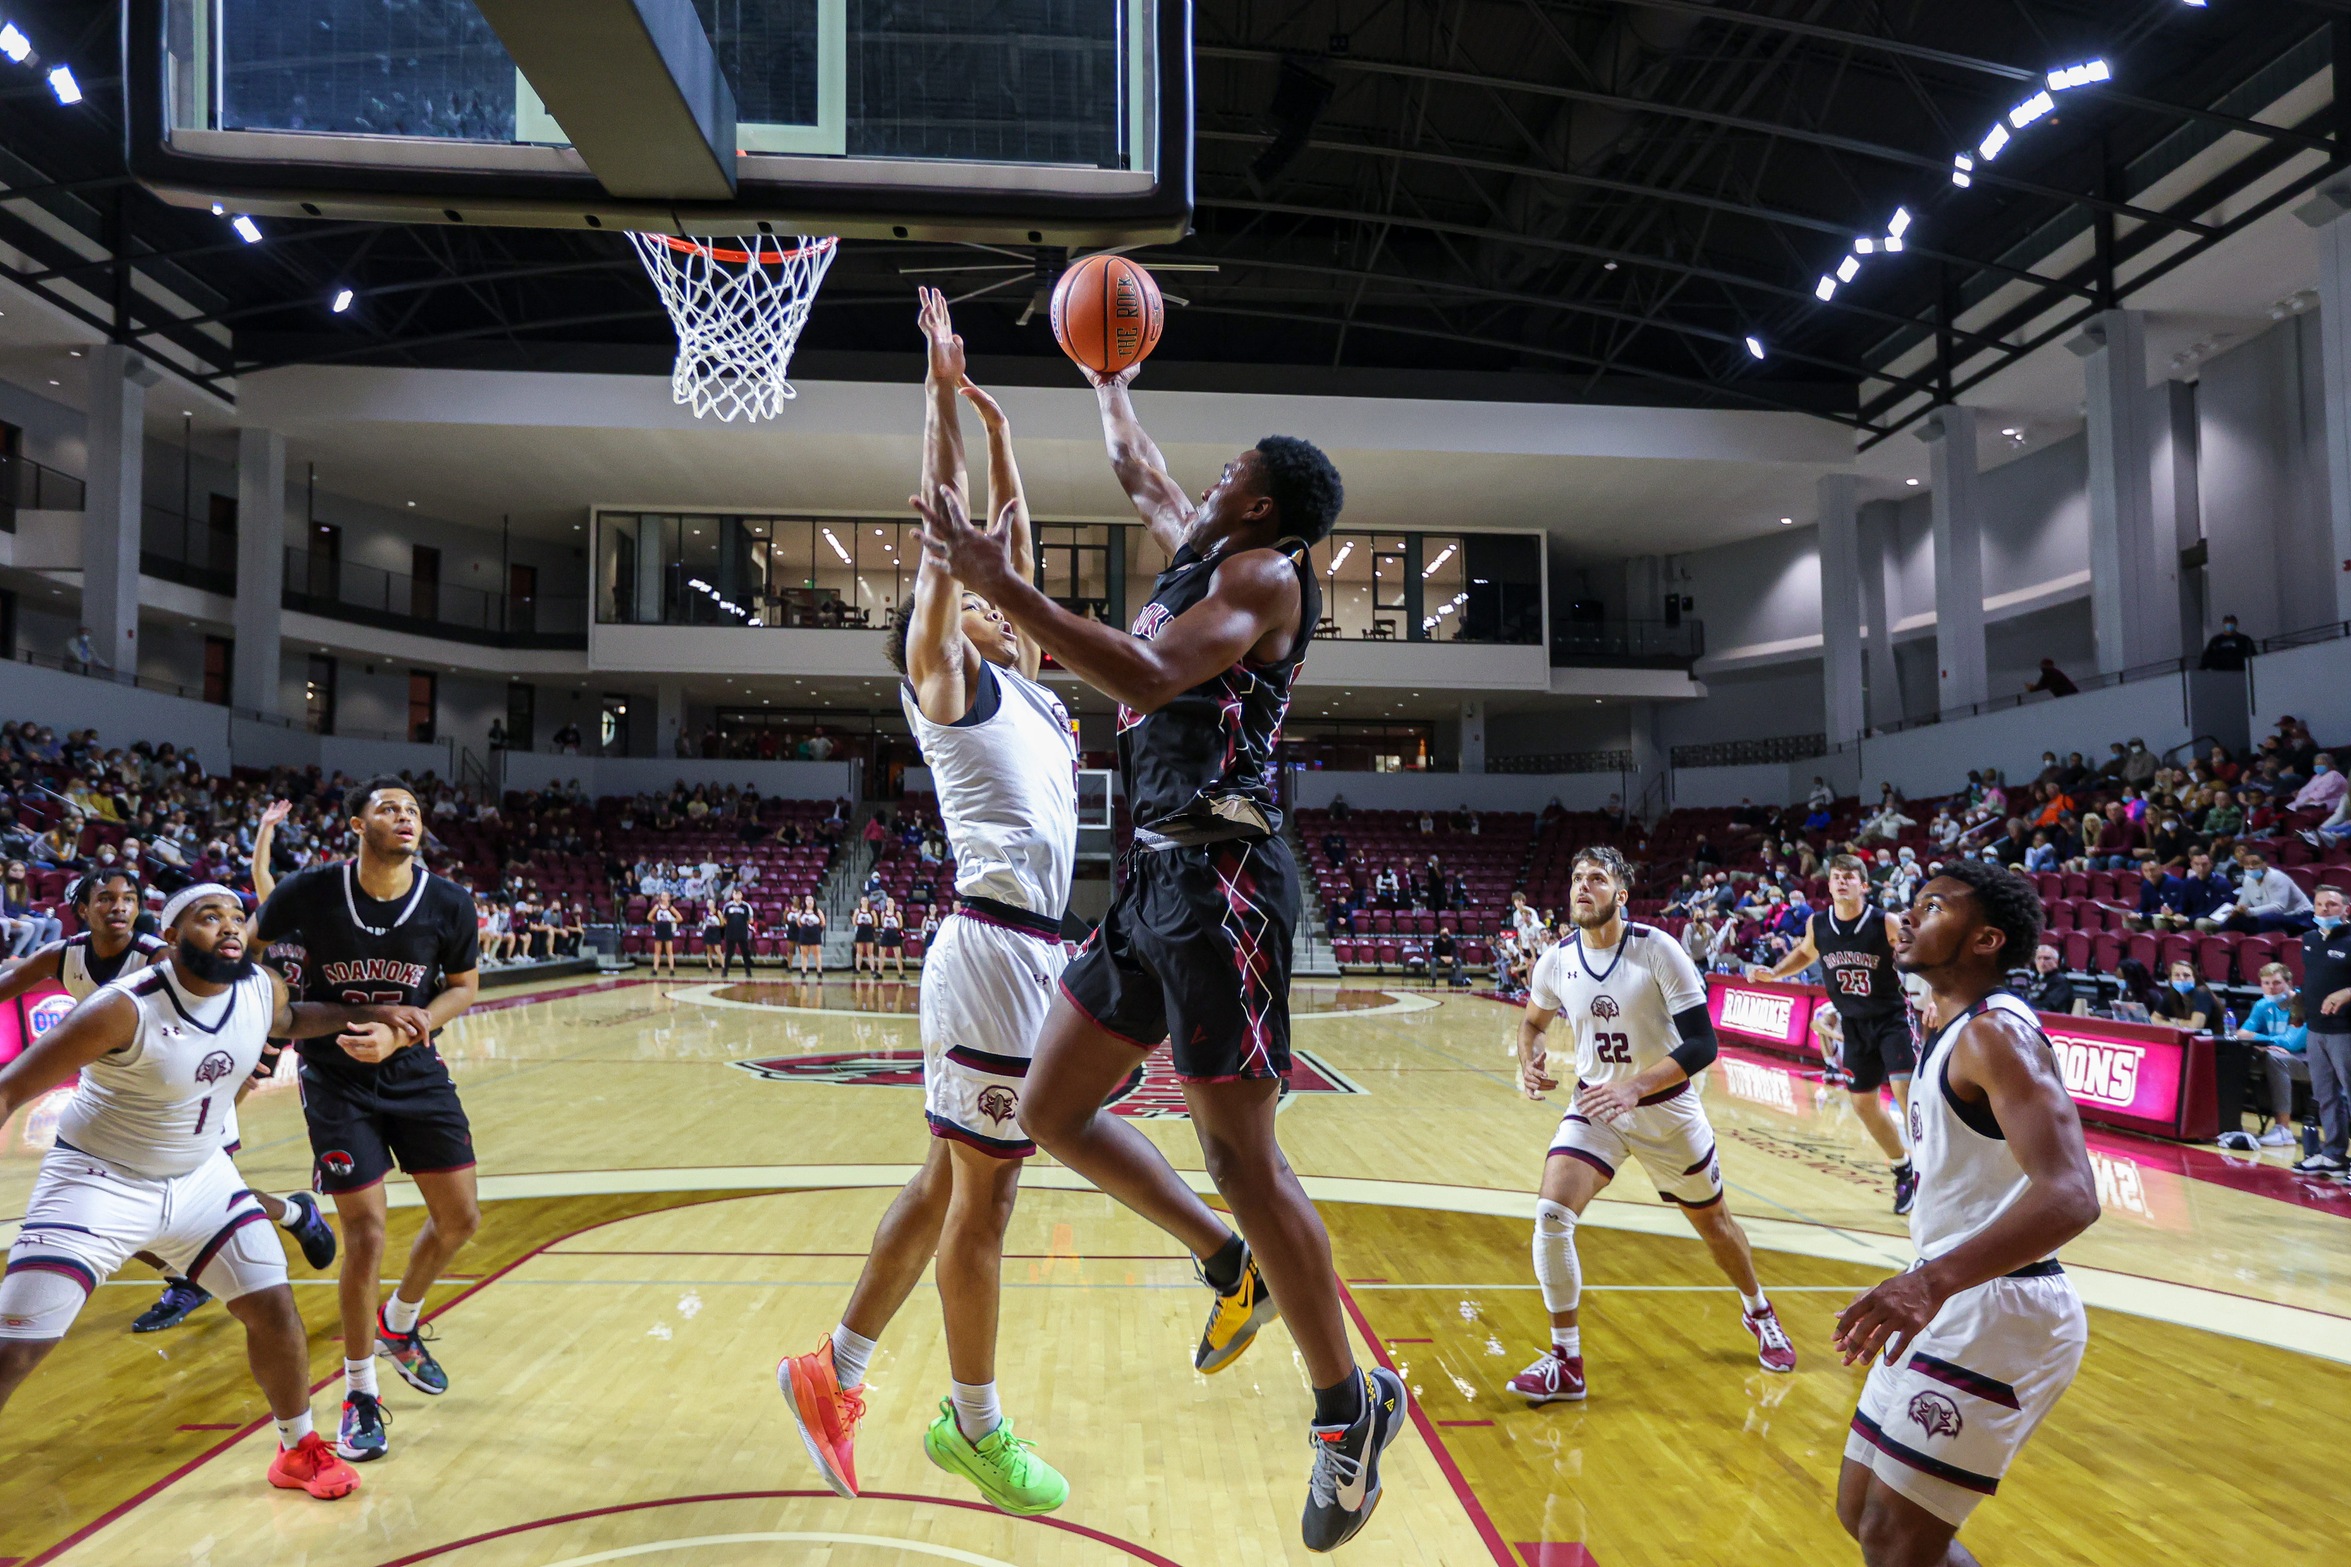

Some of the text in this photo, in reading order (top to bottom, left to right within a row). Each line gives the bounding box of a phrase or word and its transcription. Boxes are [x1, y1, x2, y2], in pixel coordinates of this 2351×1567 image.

[1116, 276, 1139, 358] THE ROCK
[1822, 951, 1880, 970] ROANOKE
[1836, 969, 1872, 997] 23
[1721, 990, 1791, 1036] ROANOKE
[1594, 1032, 1633, 1064] 22
[193, 1096, 212, 1135] 1
